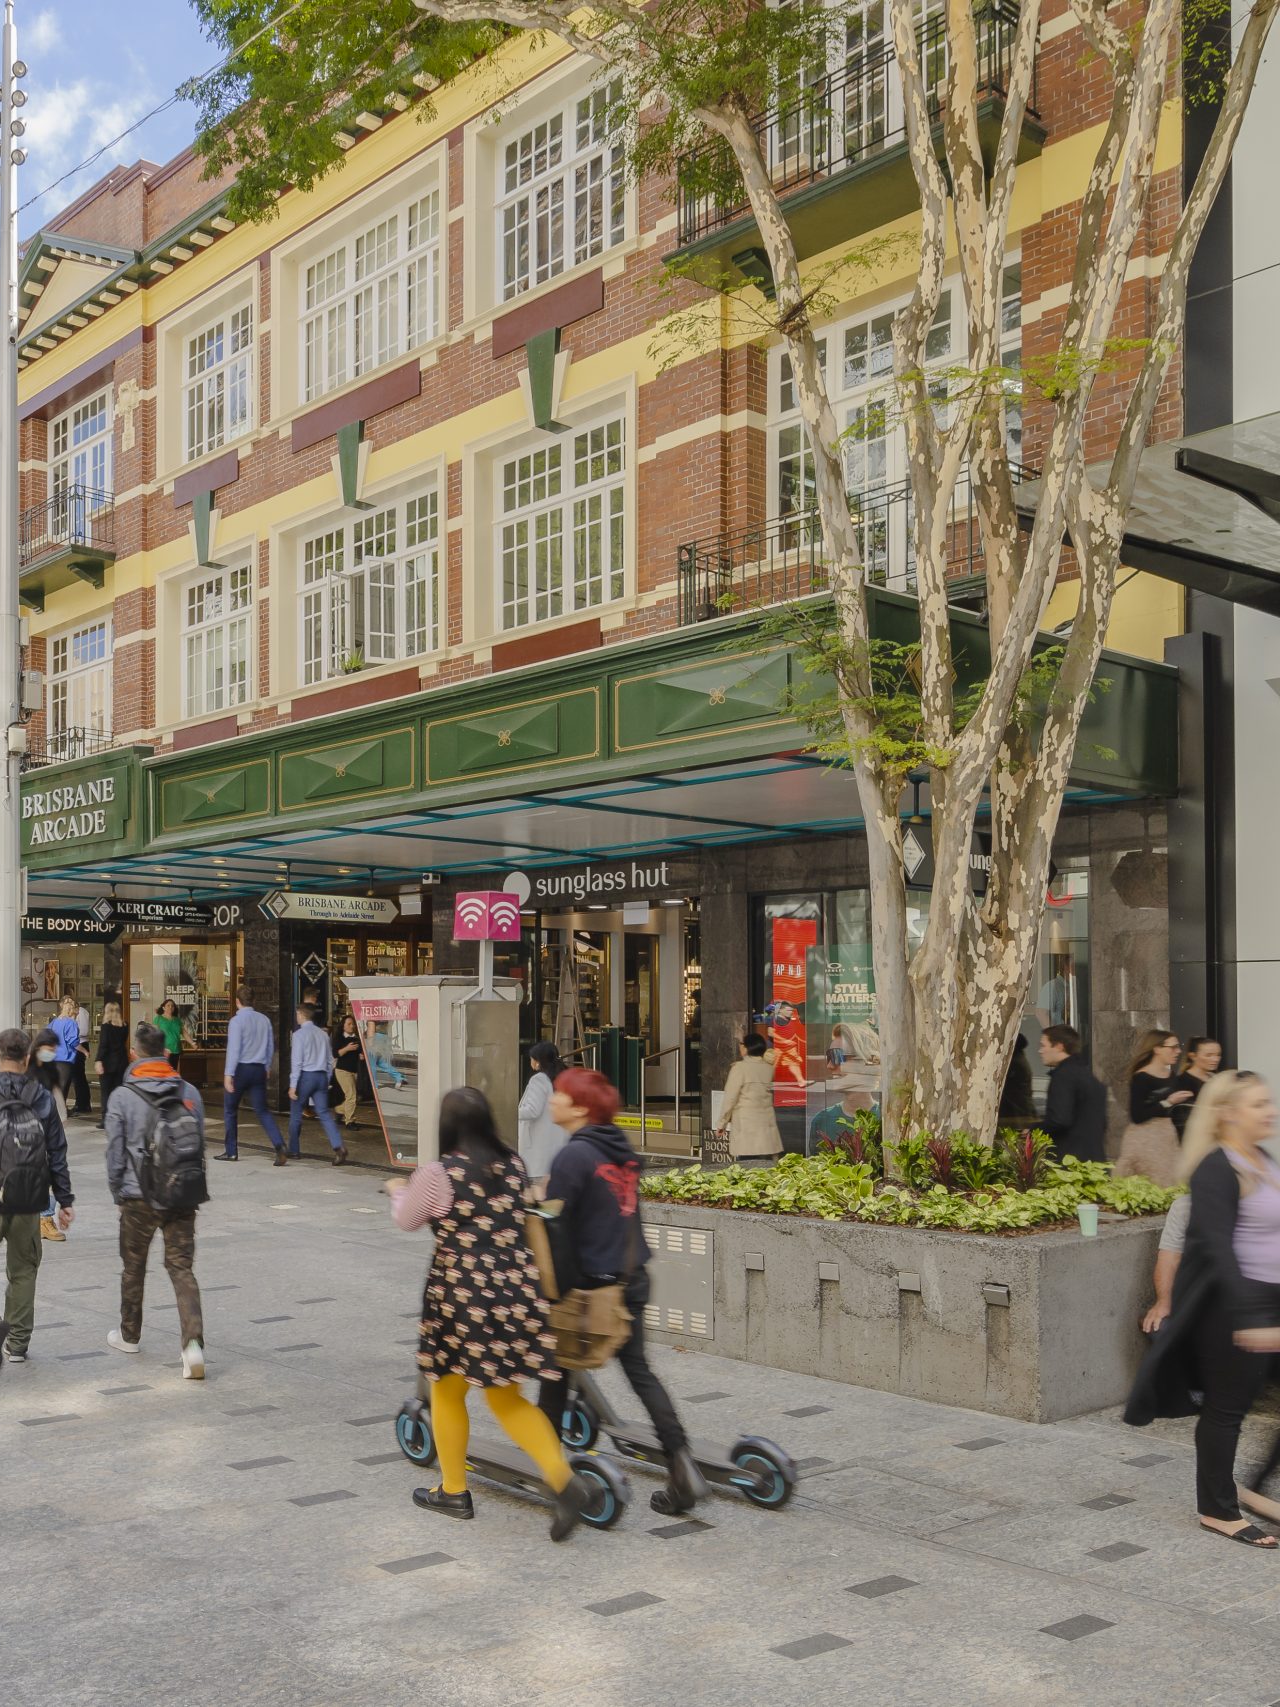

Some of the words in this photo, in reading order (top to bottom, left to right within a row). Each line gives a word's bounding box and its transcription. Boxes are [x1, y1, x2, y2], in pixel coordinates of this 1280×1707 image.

[22, 777, 115, 819] BRISBANE
[30, 809, 107, 845] ARCADE
[536, 866, 626, 900] sunglass
[631, 861, 670, 888] hut
[117, 902, 145, 915] KERI
[147, 904, 184, 917] CRAIG
[298, 896, 347, 910] BRISBANE
[348, 900, 387, 912] ARCADE
[310, 909, 332, 919] Through
[20, 916, 44, 930] THE
[47, 918, 82, 932] BODY
[84, 920, 116, 933] SHOP
[166, 985, 196, 994] SLEEP.
[834, 983, 868, 994] STYLE
[825, 993, 877, 1003] MATTERS
[361, 1006, 392, 1017] TELSTRA
[705, 1141, 730, 1152] BOOS
